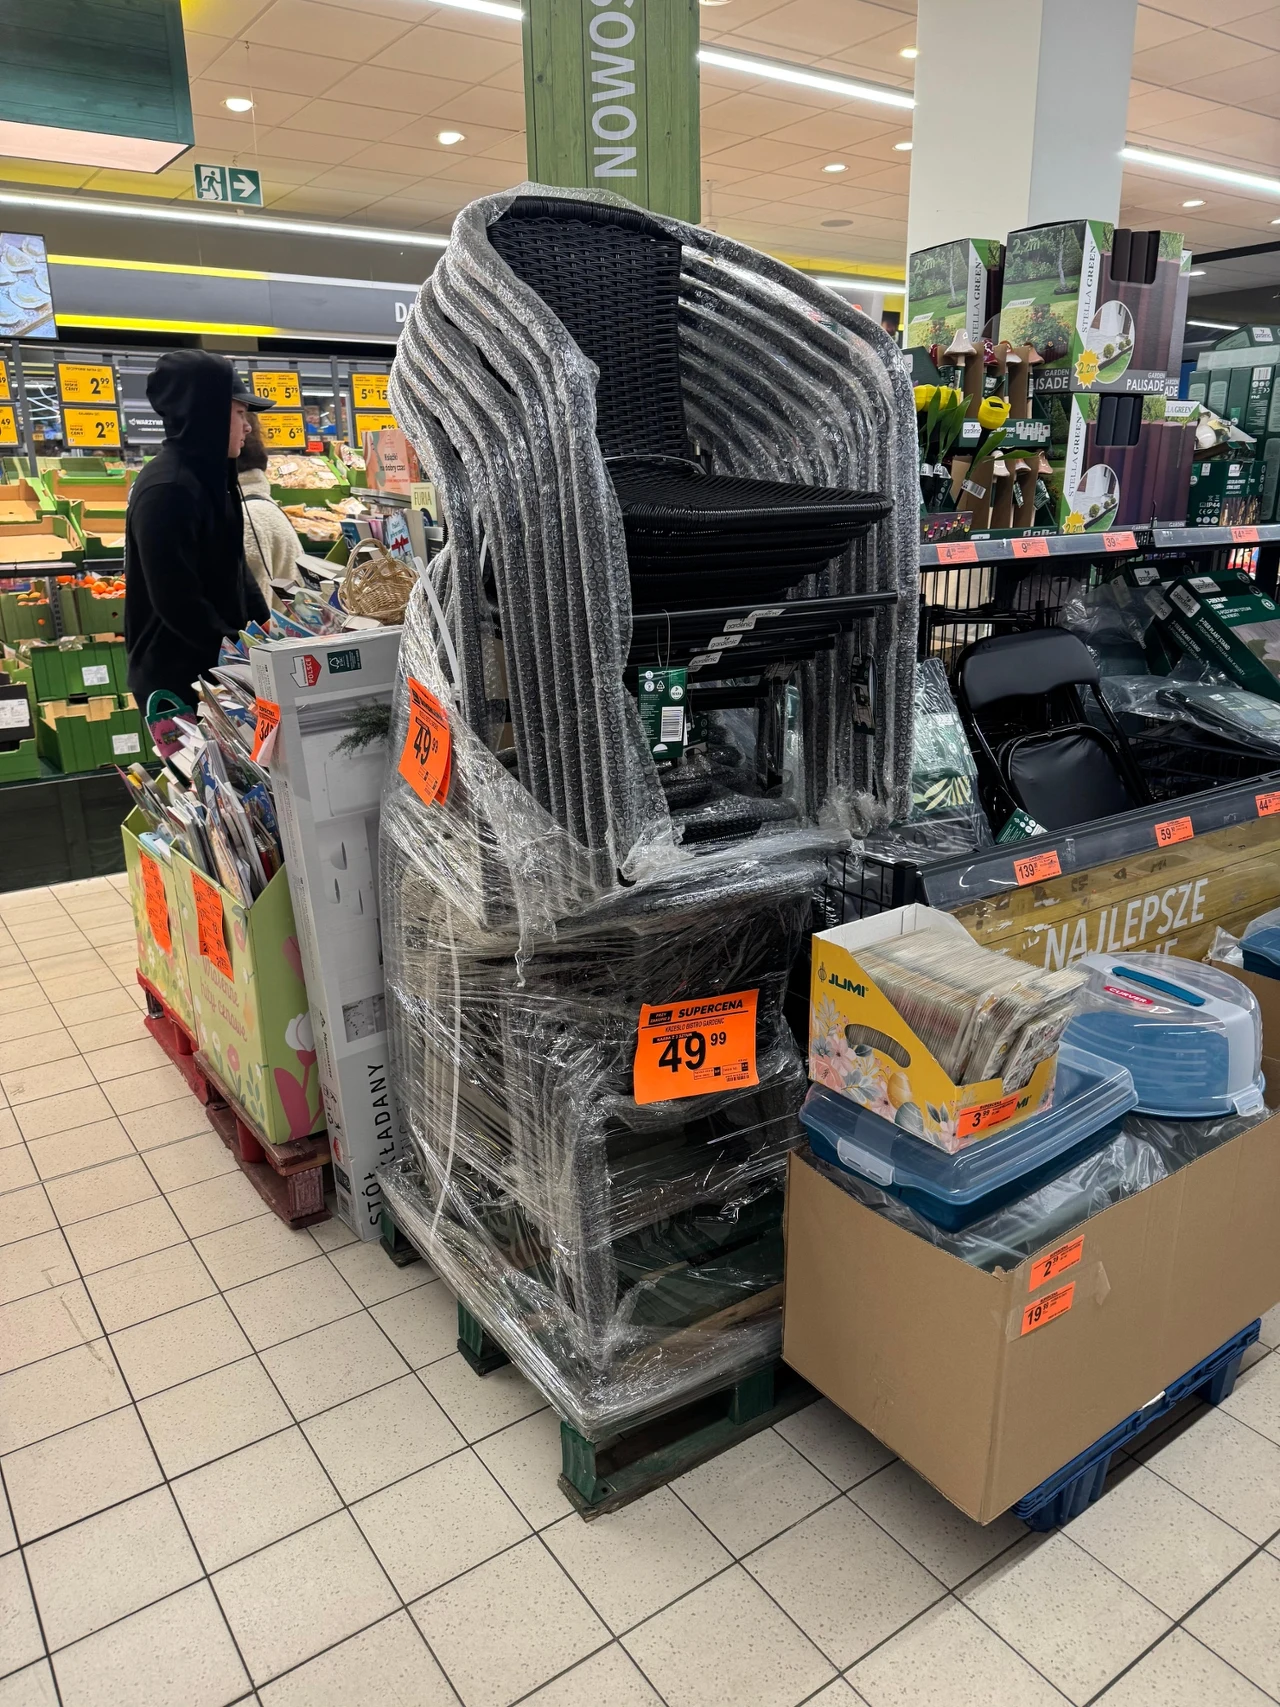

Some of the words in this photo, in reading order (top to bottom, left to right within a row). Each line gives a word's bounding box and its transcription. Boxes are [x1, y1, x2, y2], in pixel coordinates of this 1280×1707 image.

[589, 0, 637, 178] NOWO
[1081, 291, 1093, 333] STELLA
[972, 303, 980, 342] STELLA
[90, 377, 101, 394] 2
[1126, 379, 1165, 392] PALISADE
[95, 422, 106, 438] 2
[1069, 457, 1078, 497] STELLA
[1172, 590, 1195, 614] gardenic
[726, 621, 753, 630] gardenic
[711, 639, 738, 649] gardenic
[306, 657, 315, 684] POLSCE
[413, 725, 431, 765] 49
[1258, 799, 1268, 811] 44
[1160, 828, 1172, 841] 59
[1018, 864, 1035, 880] 139
[1044, 878, 1208, 971] NAJLEPSZE
[828, 973, 866, 998] JUMI
[1109, 987, 1147, 1003] CURVER
[678, 999, 743, 1018] SUPERCENA
[685, 1020, 702, 1030] BISTRO
[702, 1017, 724, 1027] GARDENIC
[658, 1031, 706, 1073] 49
[710, 1031, 727, 1047] 99
[972, 1112, 981, 1128] 3
[982, 1109, 991, 1117] 99
[1043, 1260, 1052, 1277] 2
[1027, 1306, 1042, 1325] 19
